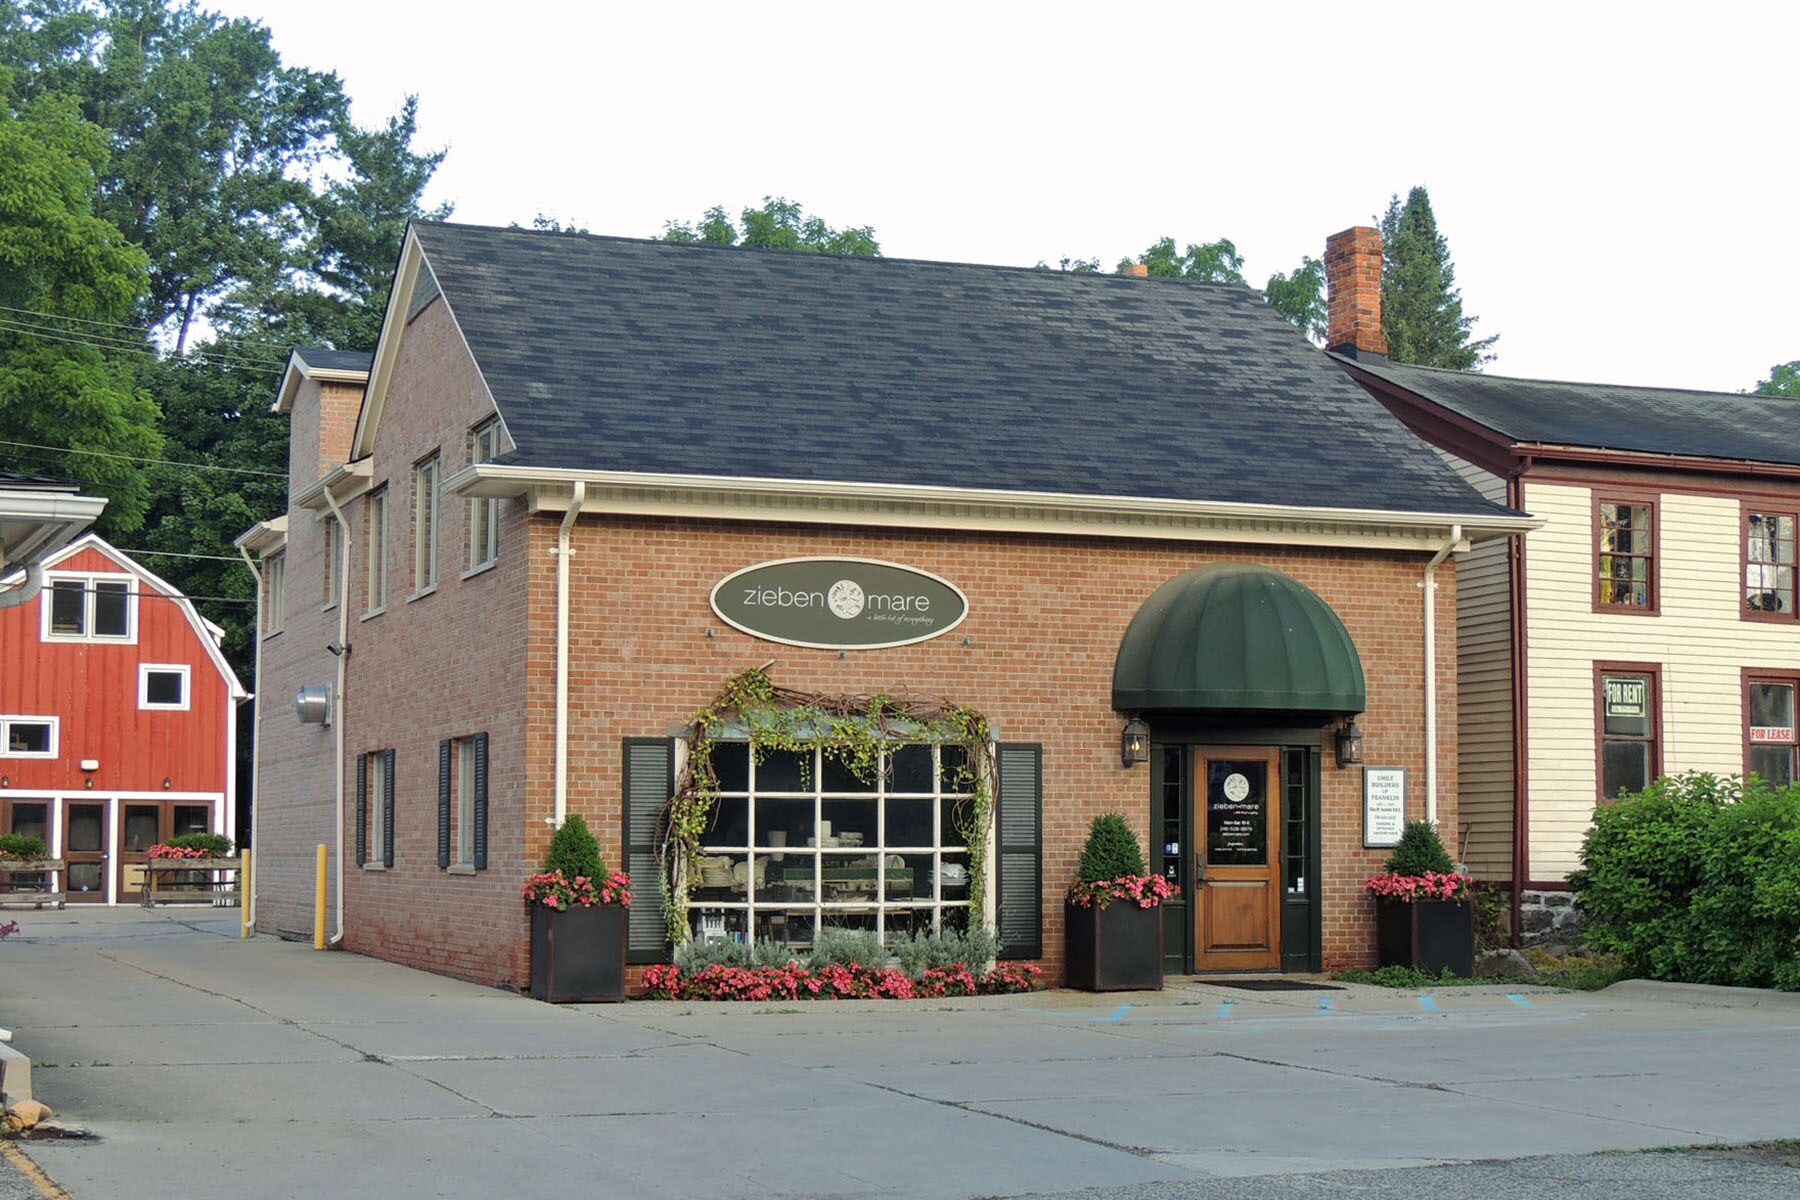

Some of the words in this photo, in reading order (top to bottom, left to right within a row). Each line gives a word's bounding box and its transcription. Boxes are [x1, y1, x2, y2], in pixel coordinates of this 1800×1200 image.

[743, 585, 824, 608] zieben
[868, 593, 930, 612] mare
[1608, 683, 1622, 703] FOR
[1623, 684, 1642, 704] RENT
[1751, 728, 1765, 739] FOR
[1767, 729, 1791, 740] LEASE
